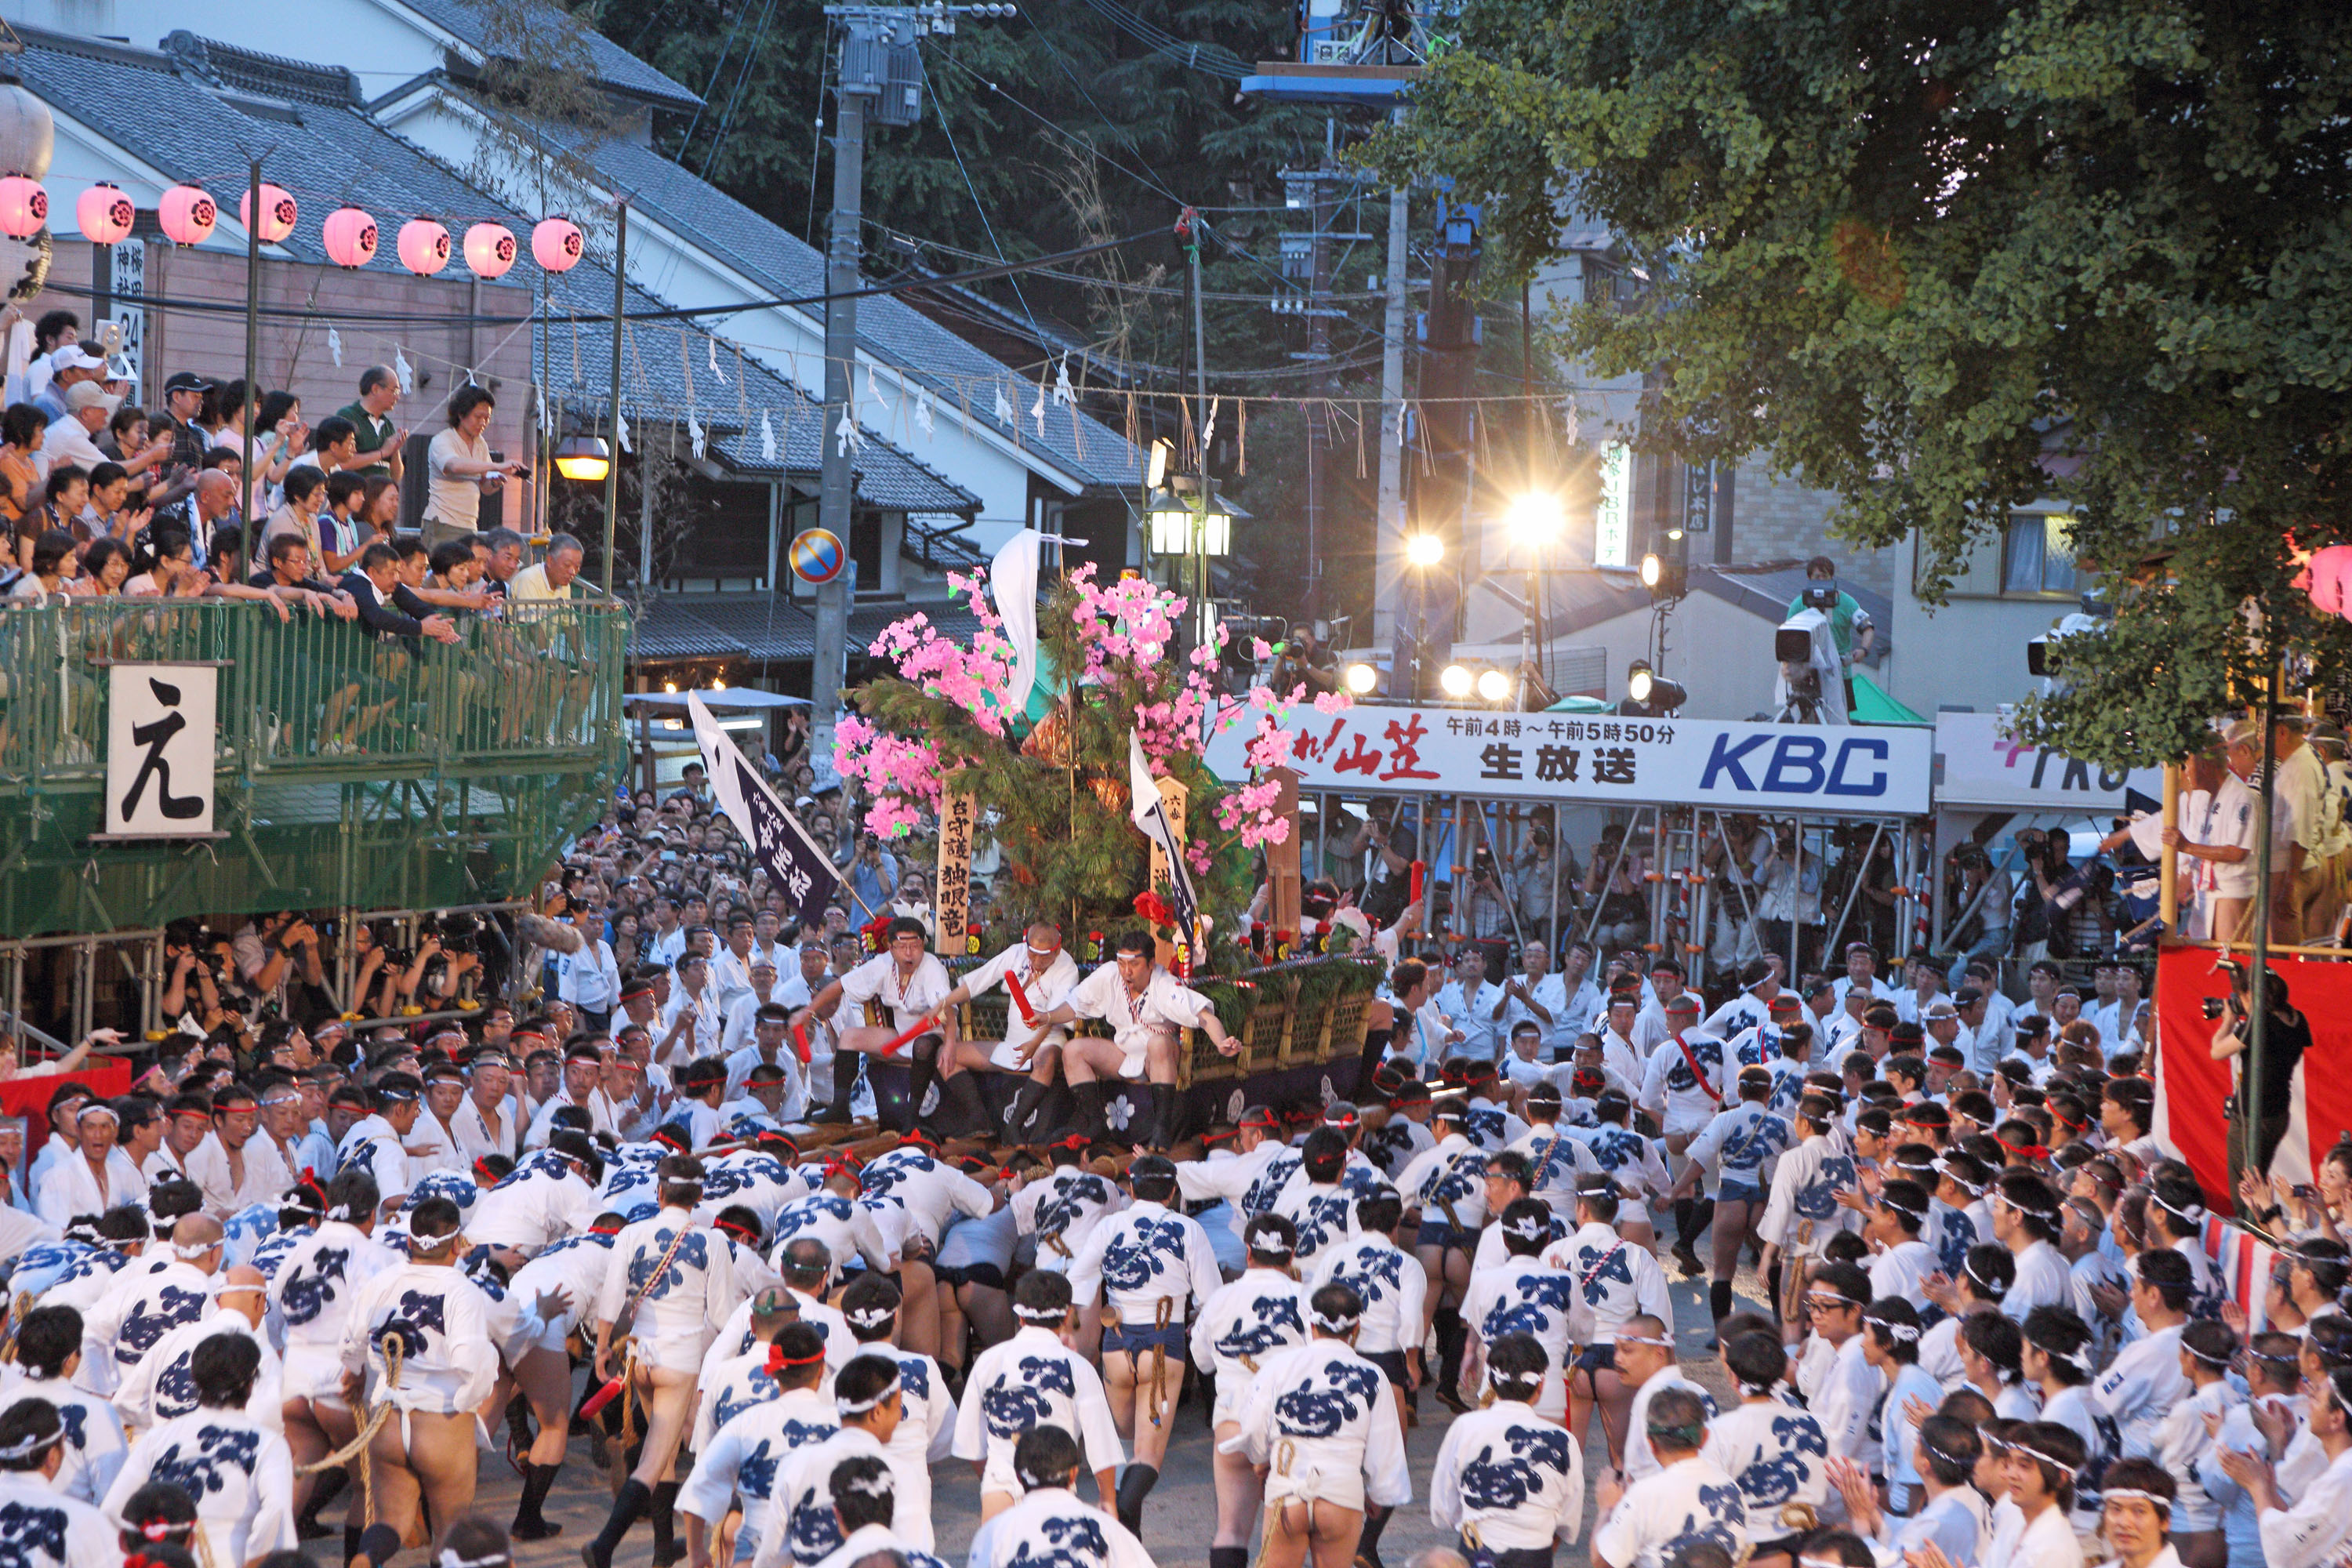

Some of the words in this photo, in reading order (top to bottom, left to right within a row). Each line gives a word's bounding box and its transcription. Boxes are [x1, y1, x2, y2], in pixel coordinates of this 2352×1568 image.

[121, 677, 205, 822] え
[1479, 742, 1636, 784] 生放送
[1699, 732, 1889, 797] KBC
